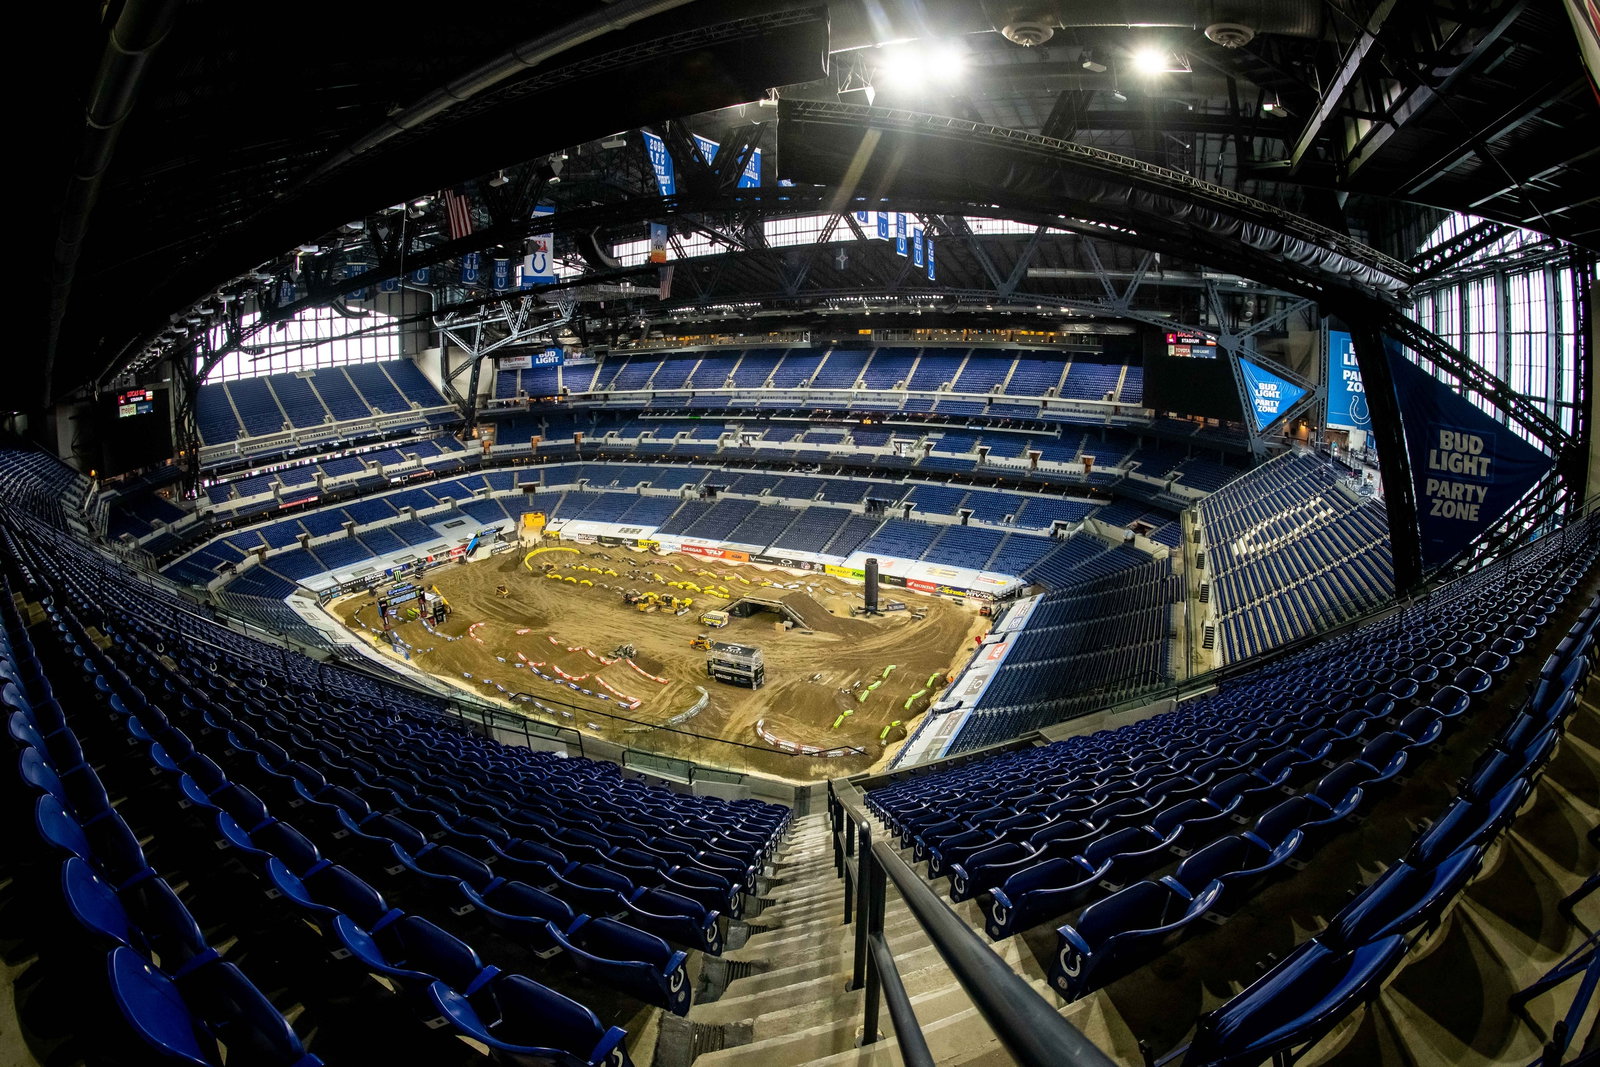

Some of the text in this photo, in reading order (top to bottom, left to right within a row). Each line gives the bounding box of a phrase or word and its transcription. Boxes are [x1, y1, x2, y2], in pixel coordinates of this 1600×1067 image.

[535, 356, 560, 364] LIGHT
[1258, 382, 1278, 391] BUD
[1255, 388, 1281, 399] LIGHT
[1254, 399, 1280, 408] PARTY
[1257, 405, 1278, 414] ZONE
[1439, 429, 1484, 456] BUD
[1428, 449, 1492, 477] LIGHT
[1425, 478, 1489, 504] PARTY
[1429, 498, 1480, 522] ZONE
[704, 548, 724, 556] FLY
[913, 582, 935, 590] HONDA
